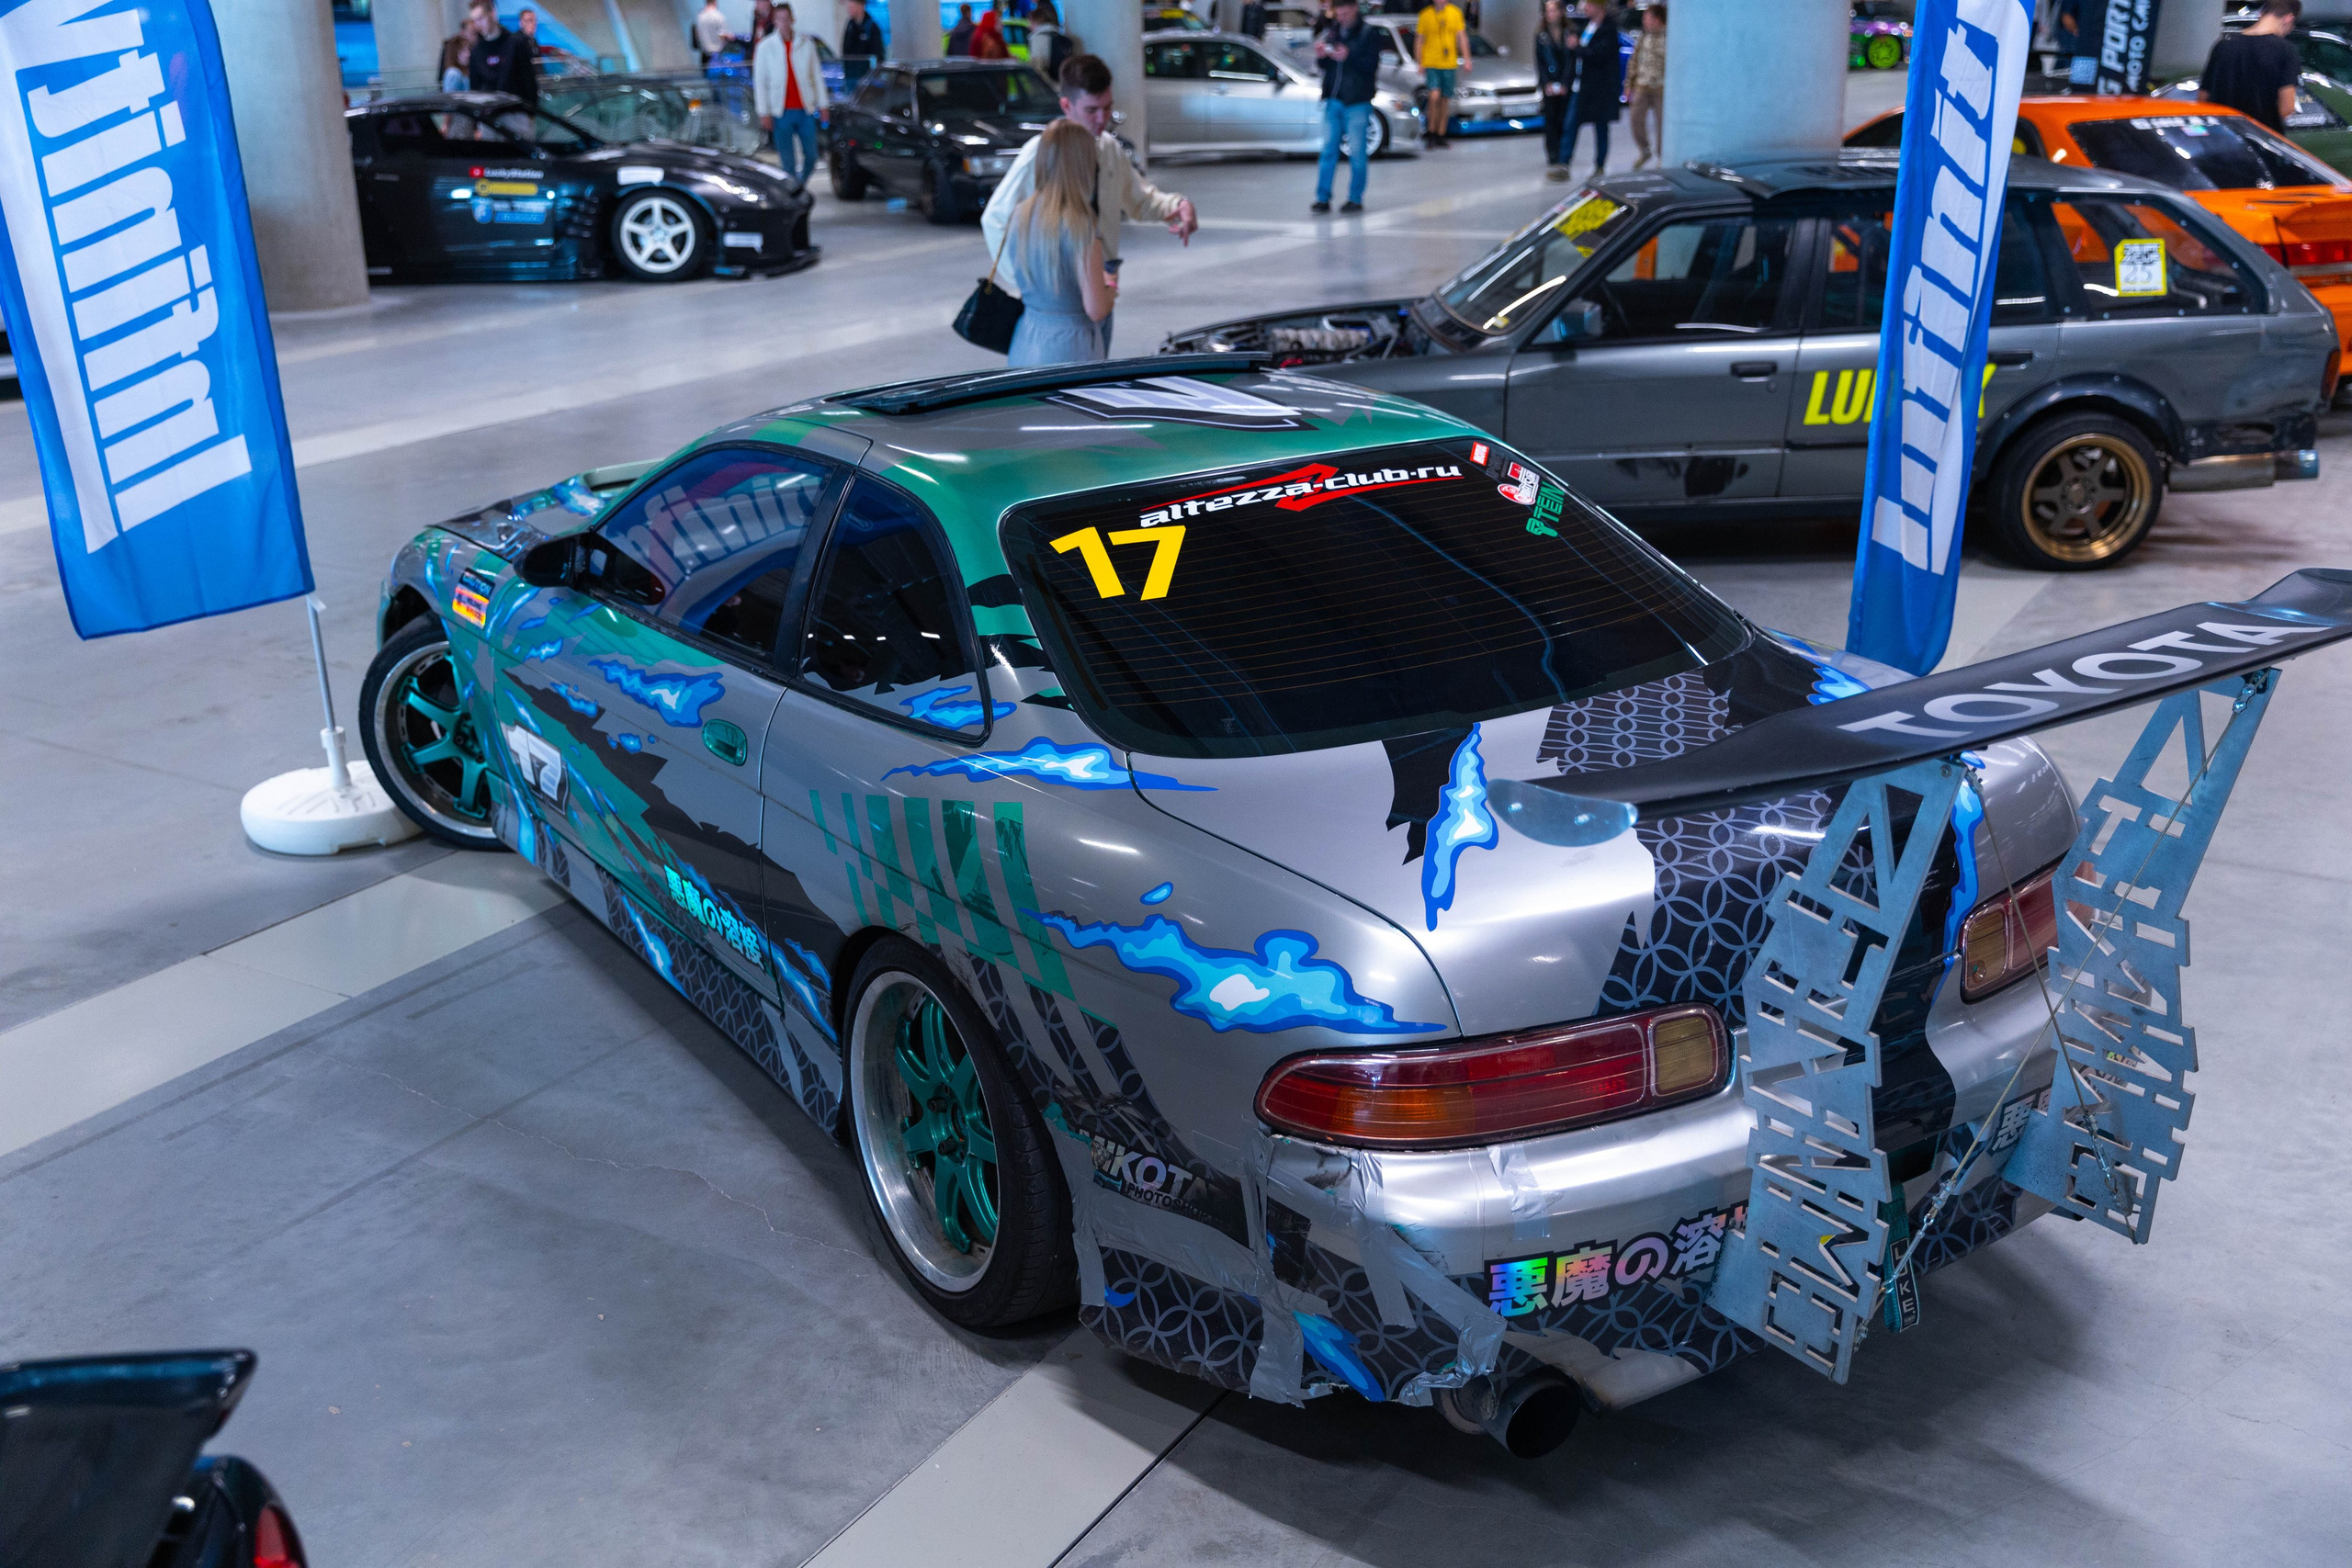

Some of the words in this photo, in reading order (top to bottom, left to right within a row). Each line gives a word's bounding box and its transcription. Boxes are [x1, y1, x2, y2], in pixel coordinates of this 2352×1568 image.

[1532, 481, 1566, 523] TEIN
[1049, 525, 1187, 602] 17
[1837, 622, 2324, 738] TOYOTA
[507, 724, 562, 802] 17
[1488, 1204, 1749, 1318] 悪魔の溶
